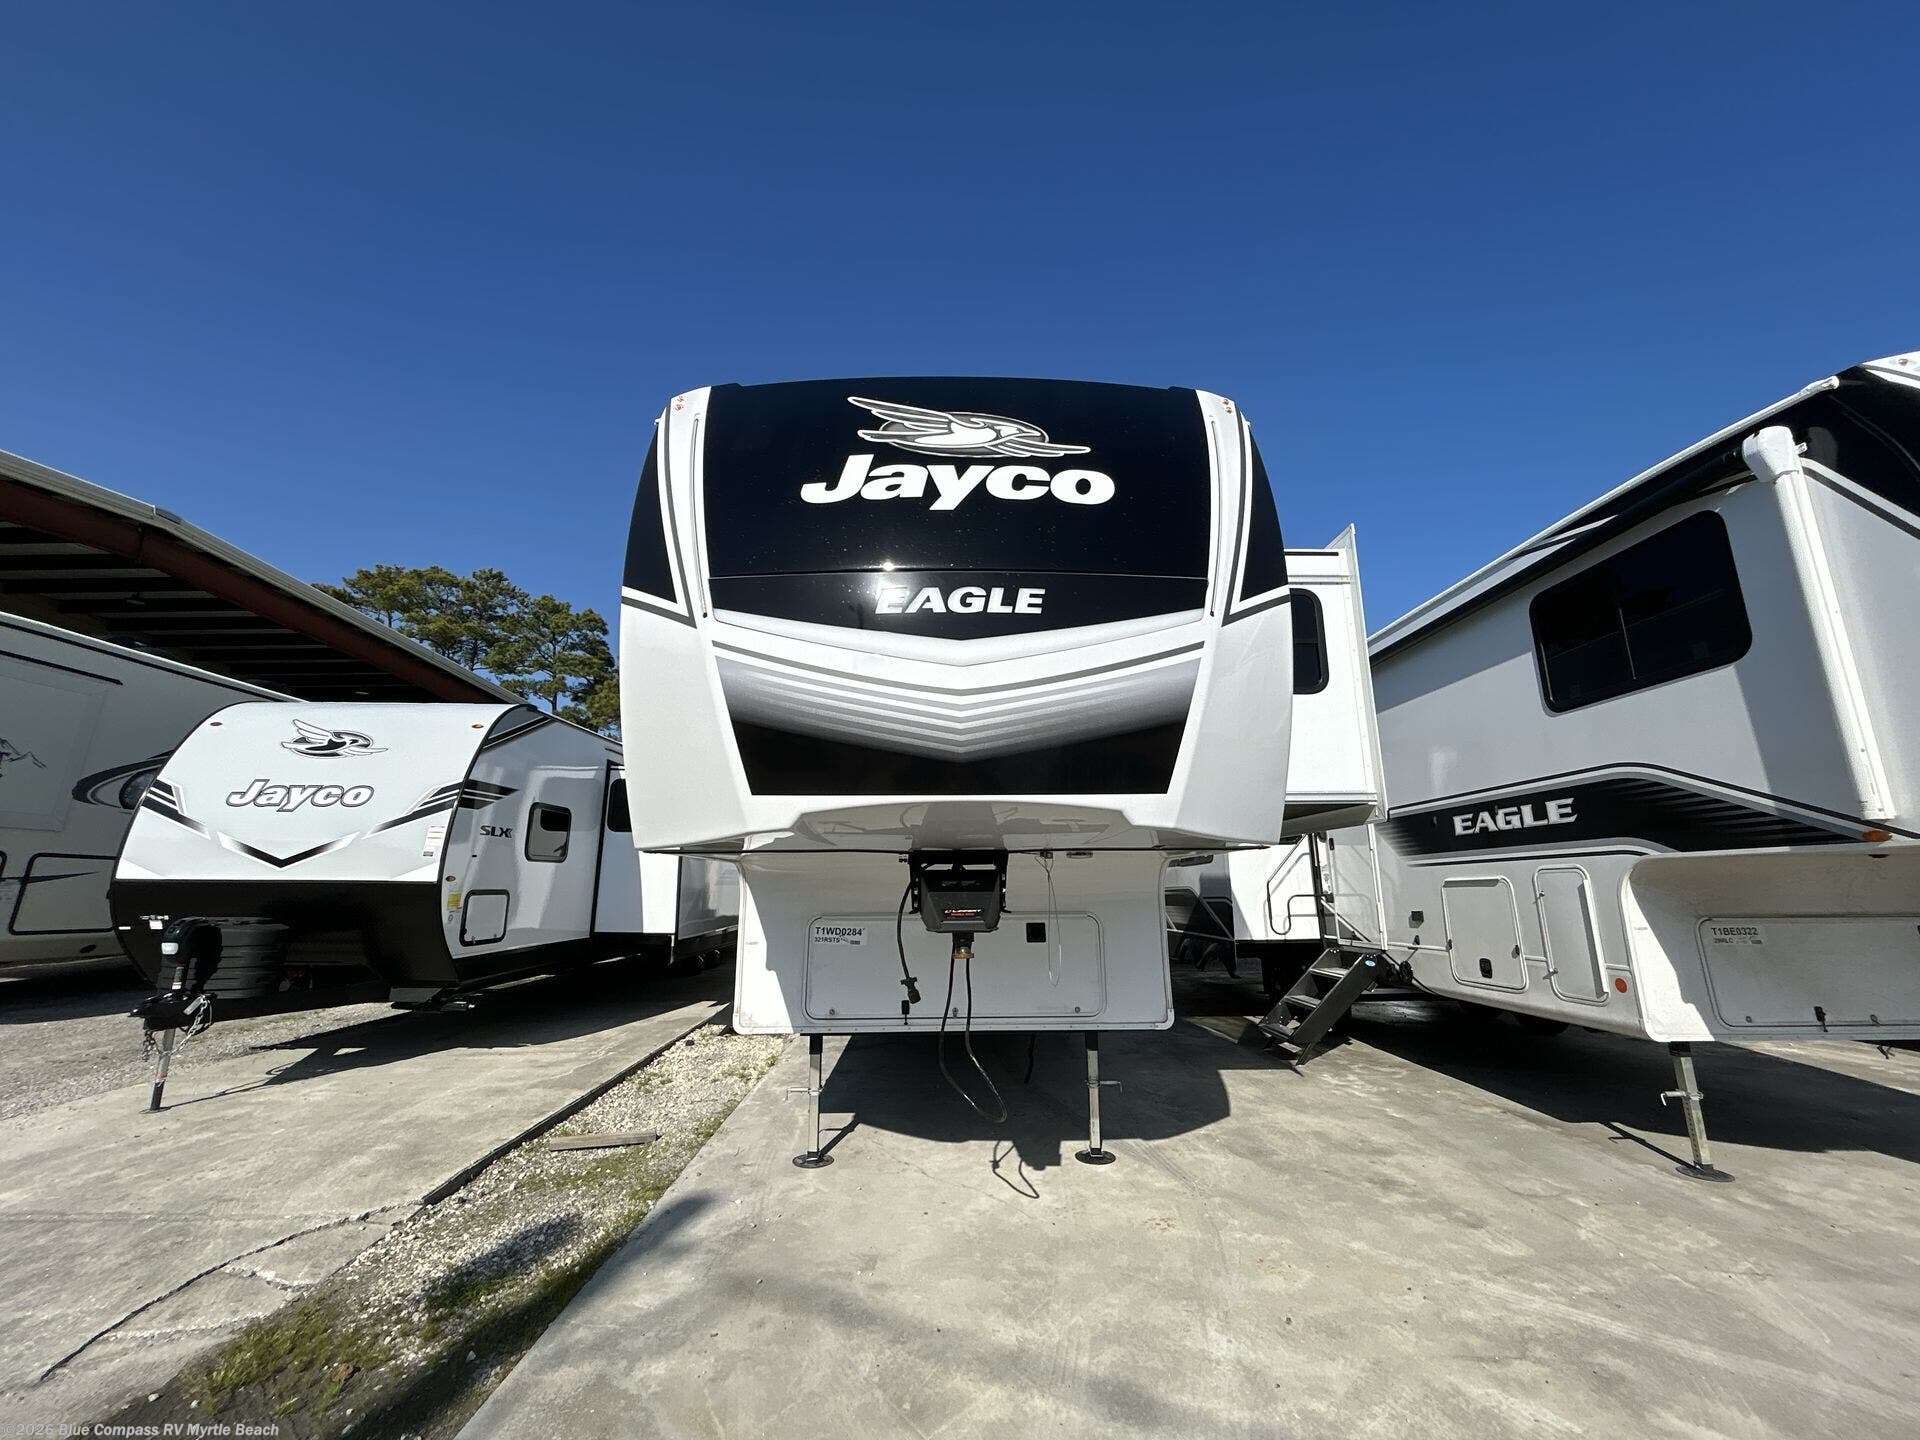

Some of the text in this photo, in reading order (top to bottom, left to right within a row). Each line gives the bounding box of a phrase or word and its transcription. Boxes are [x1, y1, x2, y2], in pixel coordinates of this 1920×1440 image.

[800, 454, 1116, 511] Jayco
[875, 586, 1046, 614] EAGLE
[226, 779, 375, 812] Jayco
[1453, 798, 1578, 836] EAGLE
[815, 926, 863, 936] T1WD0284
